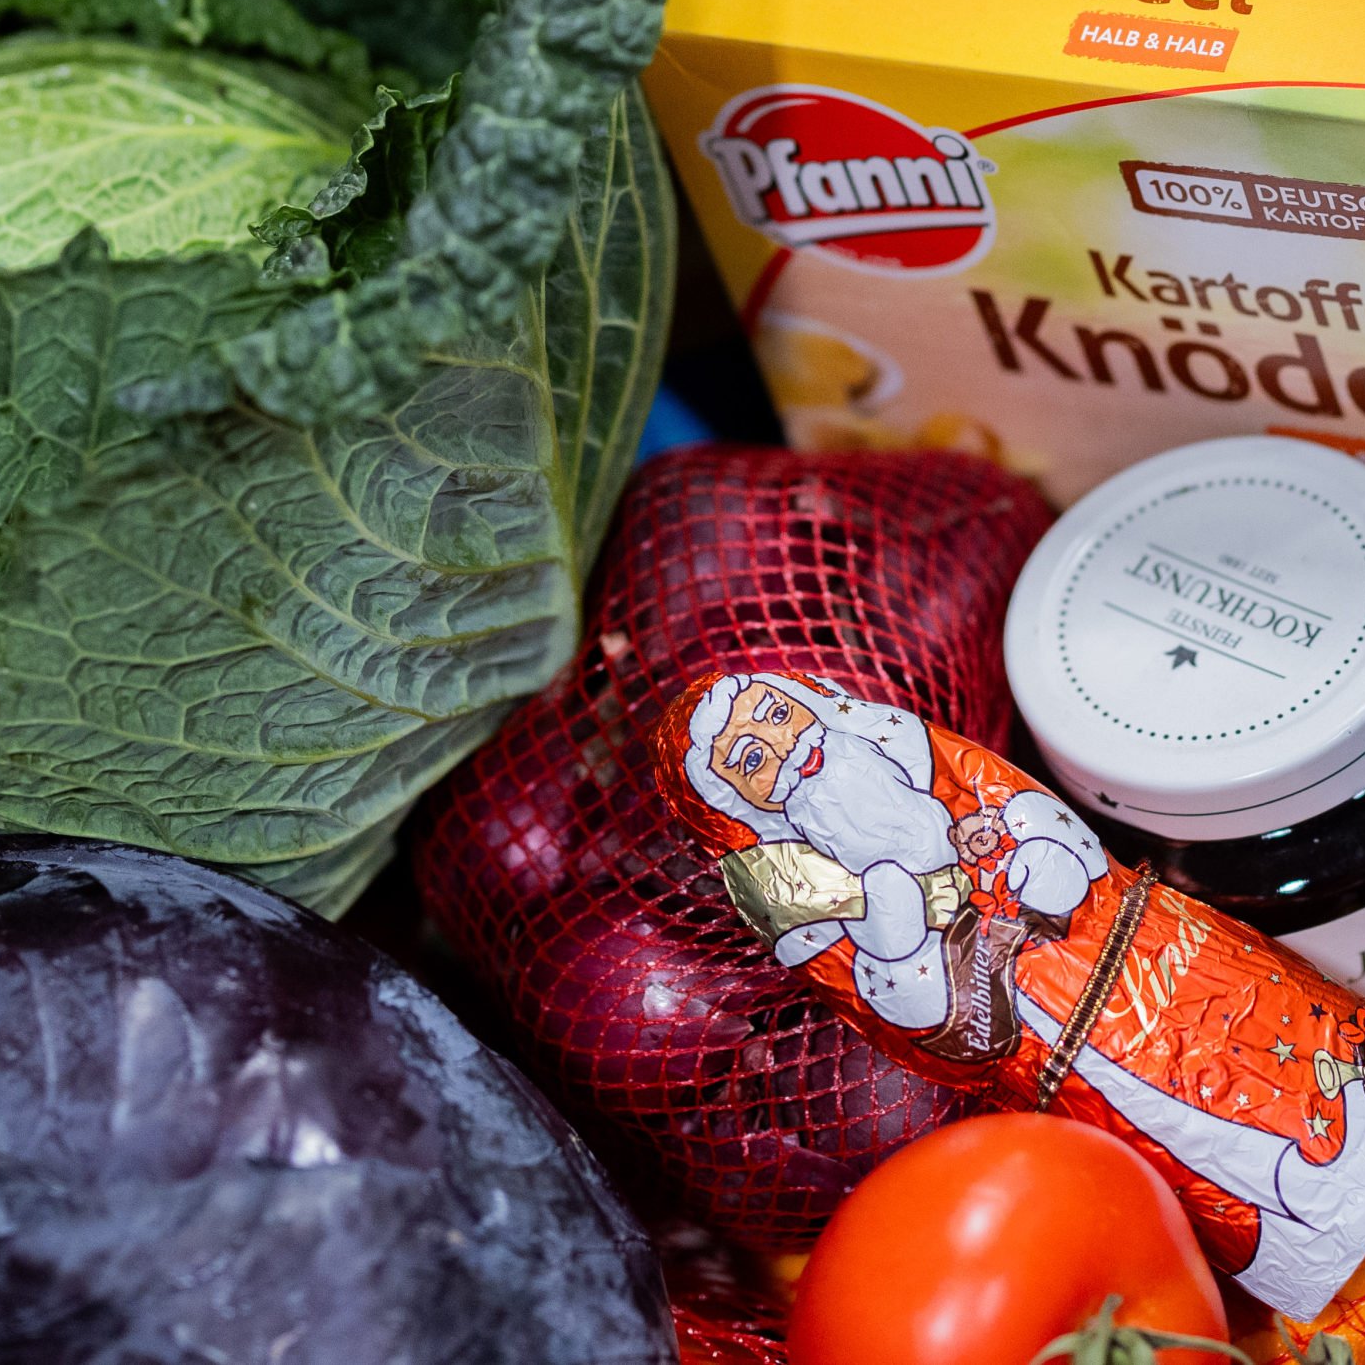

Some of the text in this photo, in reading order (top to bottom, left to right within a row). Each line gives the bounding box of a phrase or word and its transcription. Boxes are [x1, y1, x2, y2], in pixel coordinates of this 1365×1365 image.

[1080, 25, 1226, 57] HALB & HALB
[706, 135, 985, 224] Pfanni
[1149, 179, 1243, 210] 100%
[1124, 554, 1324, 648] KOCHKUNST
[1166, 608, 1243, 649] FEINSTE
[968, 936, 991, 1051] Edelbitter
[1101, 890, 1212, 1057] Lindt
